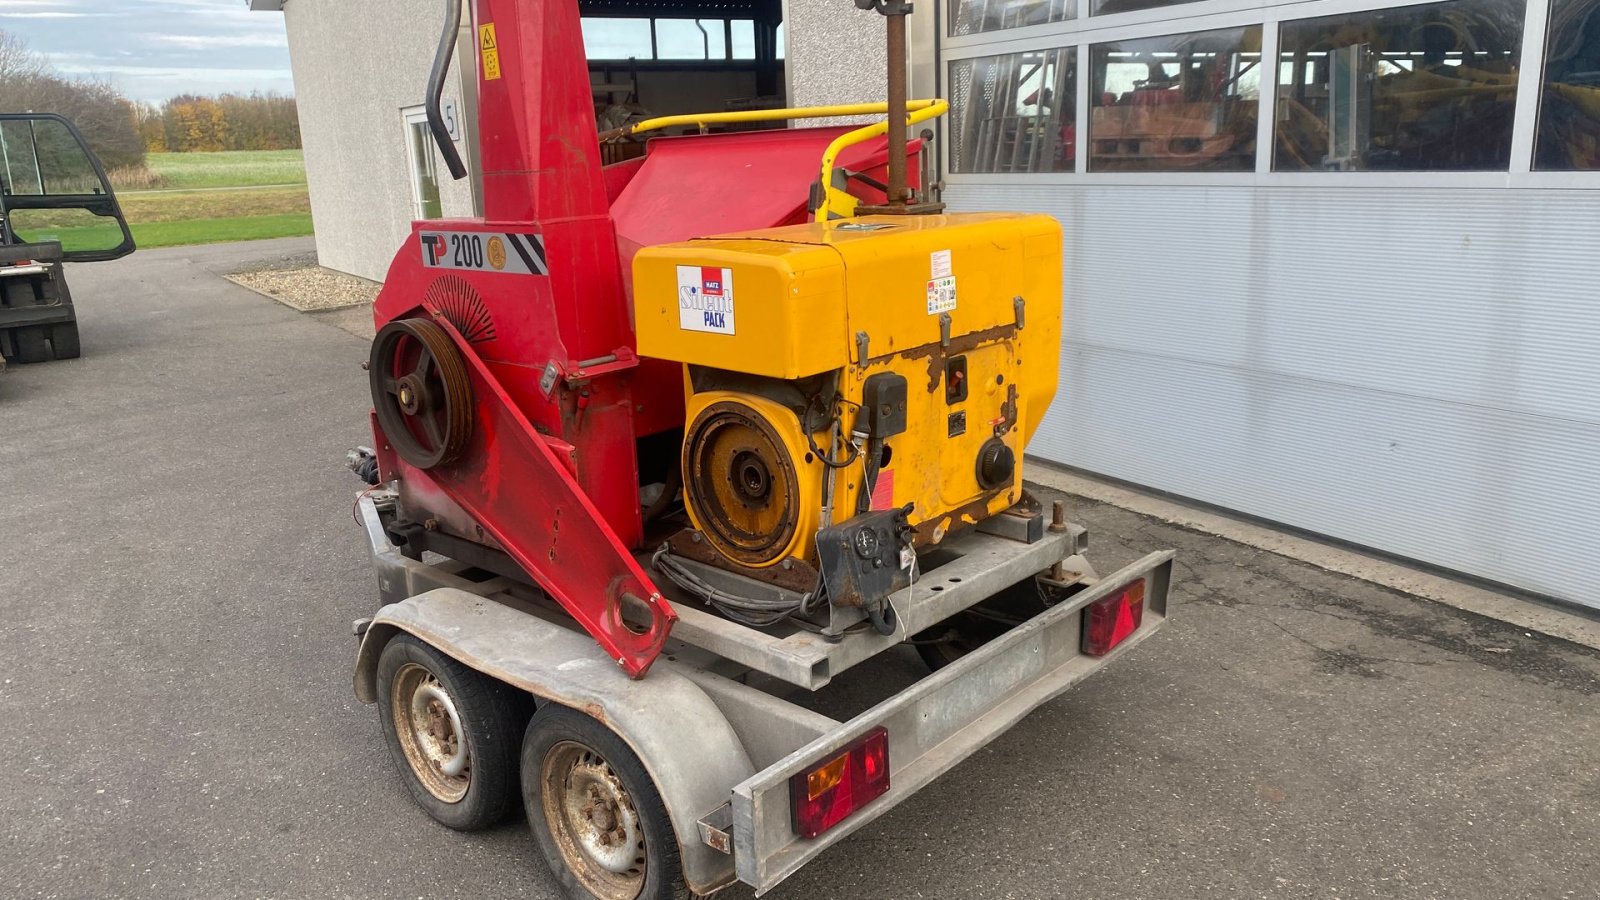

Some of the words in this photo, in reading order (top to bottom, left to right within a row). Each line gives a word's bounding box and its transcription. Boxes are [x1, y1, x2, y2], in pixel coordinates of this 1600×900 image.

[446, 105, 455, 134] 5
[421, 234, 447, 266] TP
[452, 233, 483, 268] 200
[705, 281, 719, 289] HATZ
[680, 286, 732, 313] Silent
[704, 311, 725, 328] PACK
